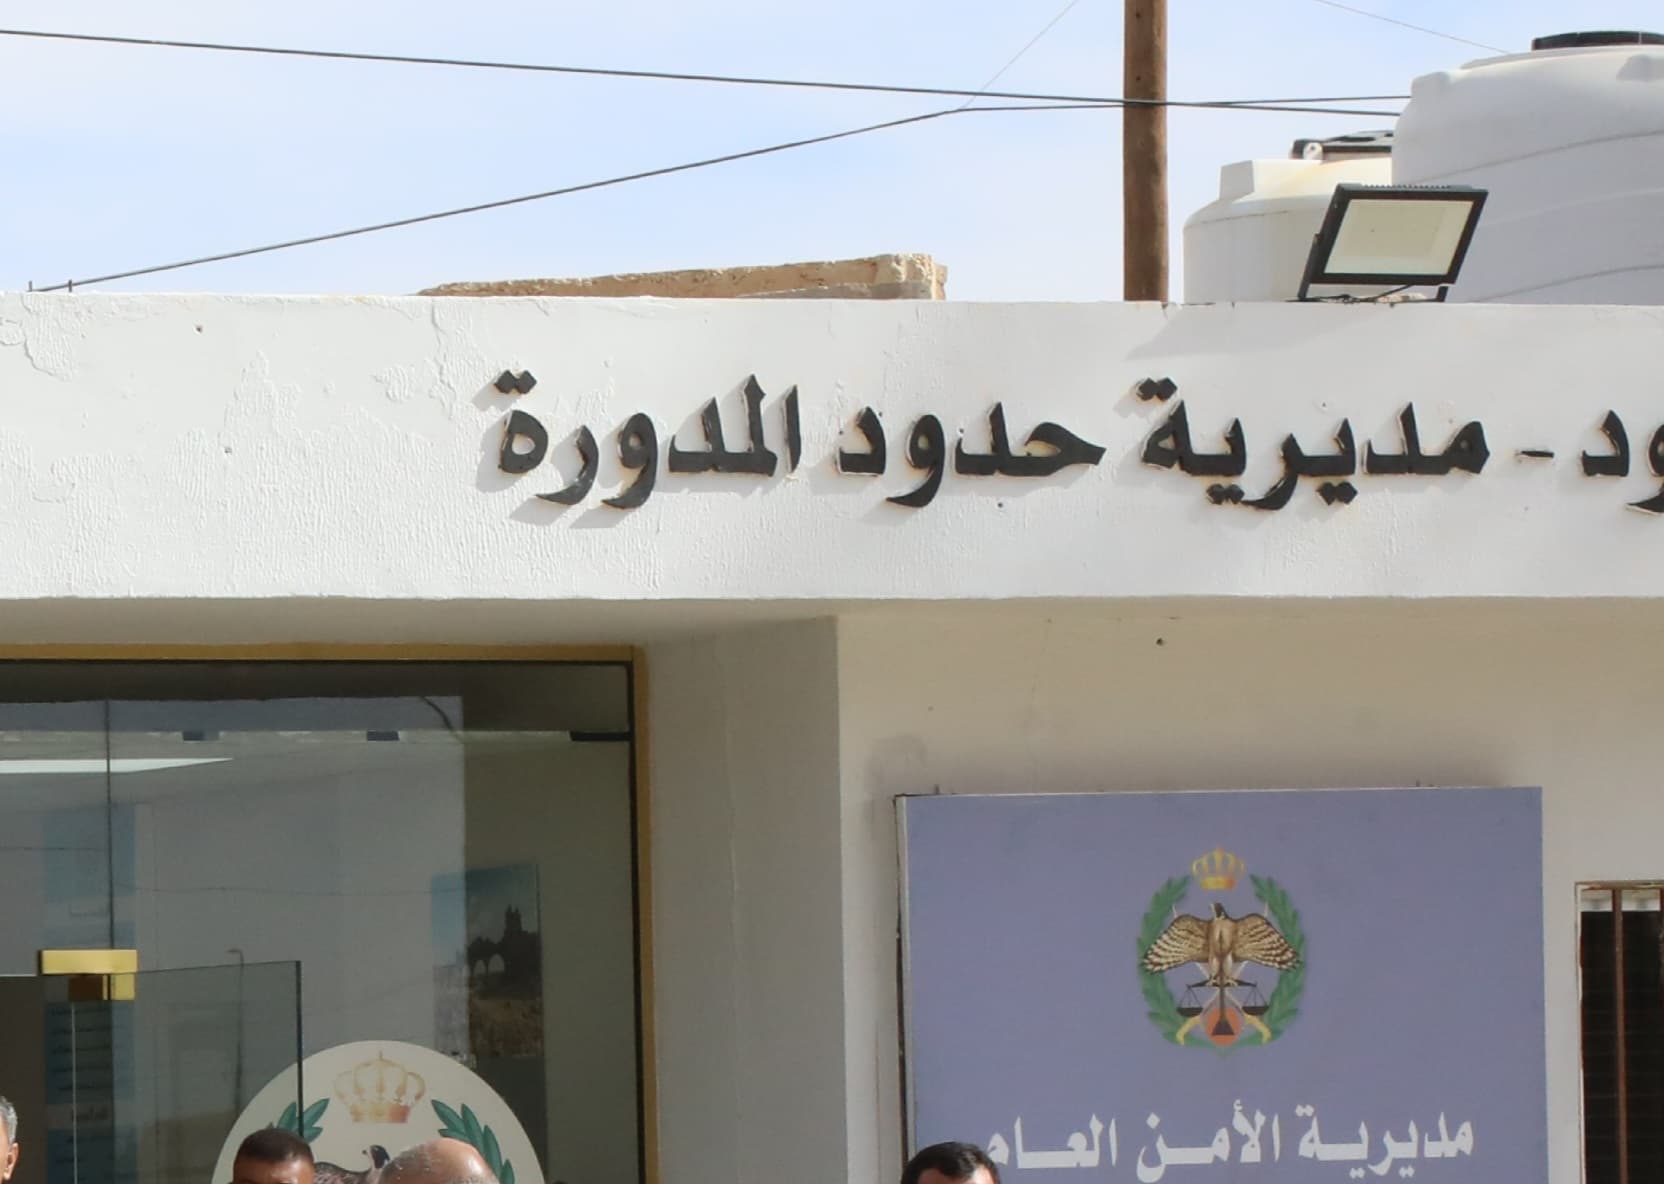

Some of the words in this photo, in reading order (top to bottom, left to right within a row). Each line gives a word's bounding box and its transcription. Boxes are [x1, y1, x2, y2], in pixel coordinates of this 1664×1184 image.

[492, 370, 803, 511] المدورة
[839, 402, 1106, 510] حدود
[1136, 377, 1490, 511] مديرية
[987, 1113, 1118, 1169] العام
[1136, 1098, 1281, 1184] الأمن
[1296, 1104, 1474, 1179] مديرية
